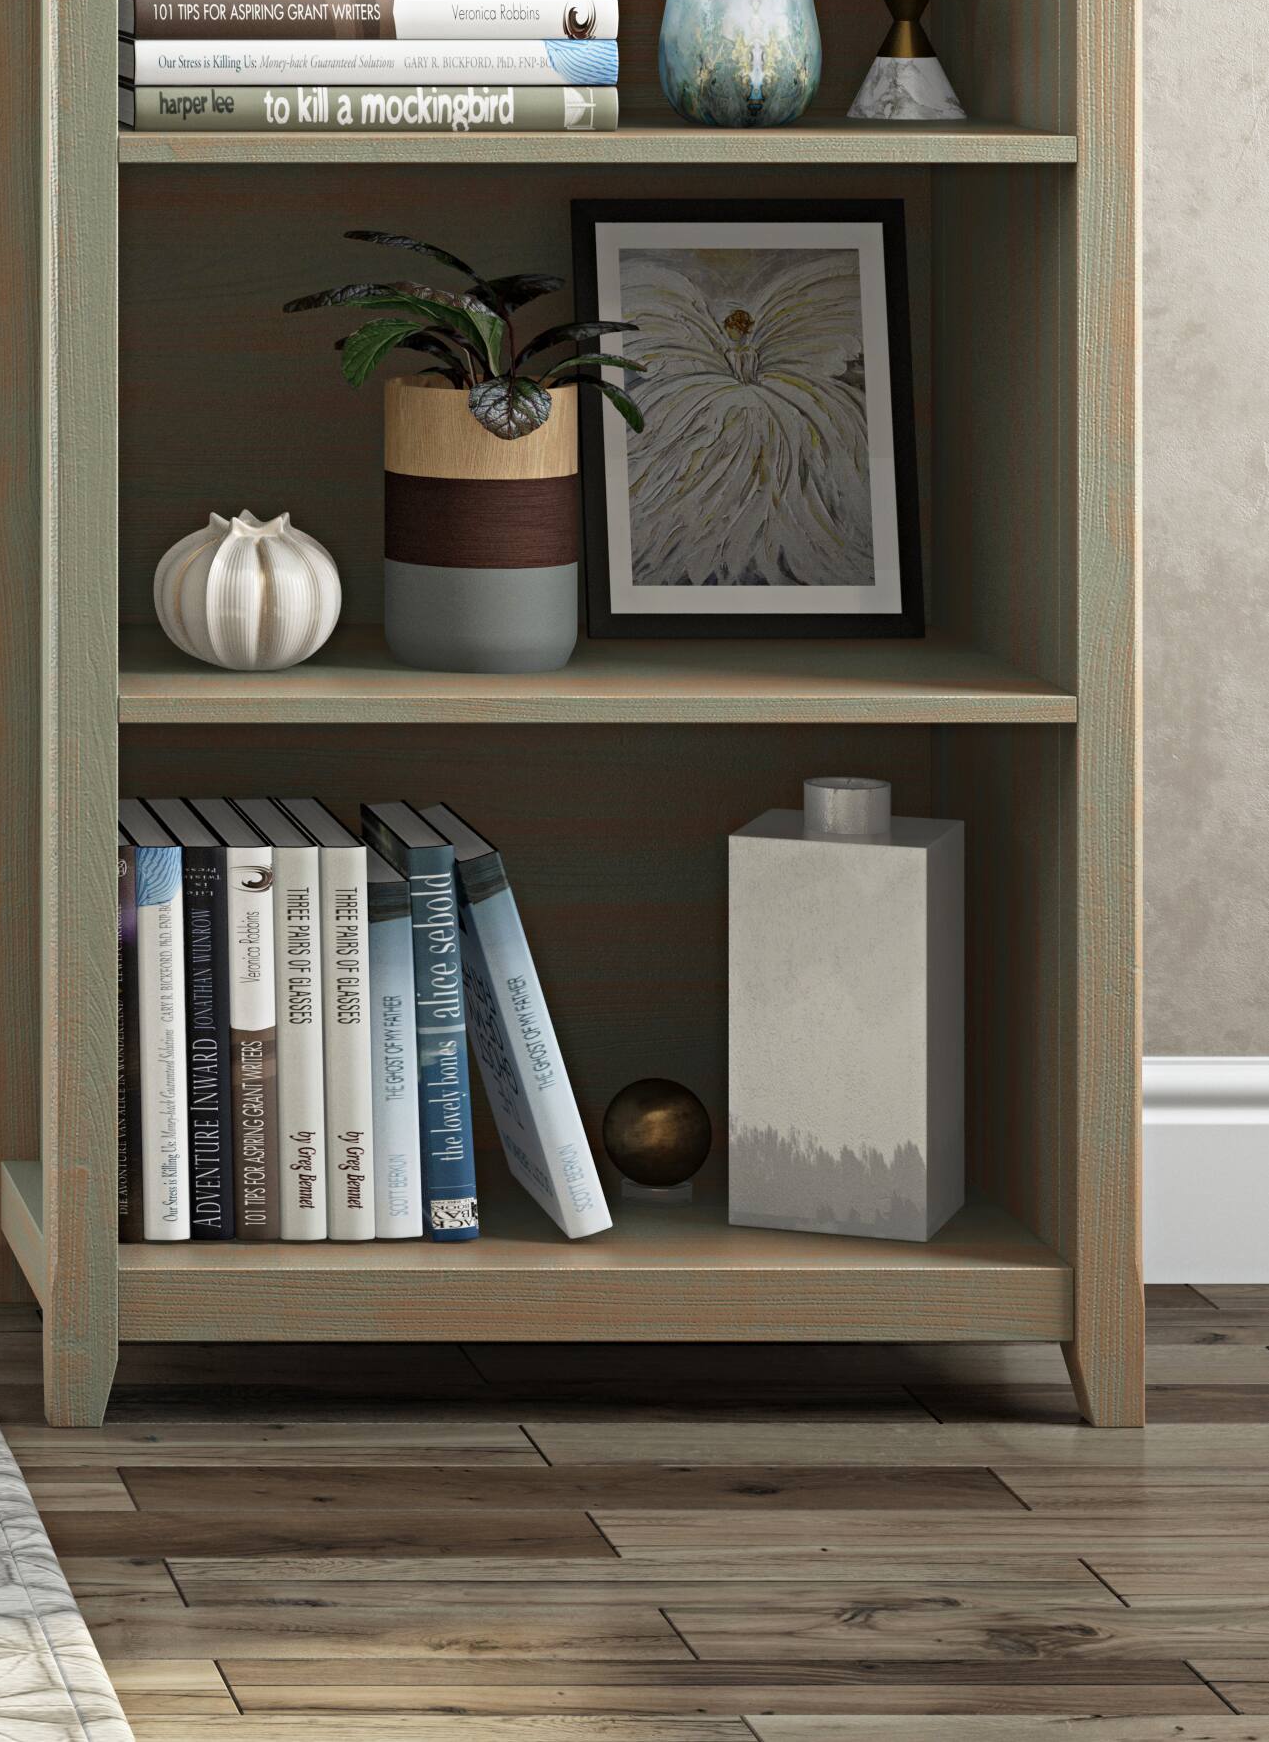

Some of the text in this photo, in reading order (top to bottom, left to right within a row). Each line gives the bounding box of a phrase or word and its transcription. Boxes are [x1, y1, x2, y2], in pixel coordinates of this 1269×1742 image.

[153, 3, 381, 20] 101 TIPS FOR ASPIRING GRANT WRITERS
[452, 4, 540, 21] Veronica Robbins
[158, 55, 176, 69] Our
[178, 55, 202, 69] Stress
[204, 56, 210, 69] is
[213, 55, 241, 73] Killing
[244, 55, 257, 69] Us:
[310, 54, 357, 69] Guaranteed
[358, 54, 395, 69] Solutions
[404, 57, 428, 69] GARY
[159, 90, 234, 120] harper lee
[264, 87, 514, 132] to kill a mockingbird
[236, 911, 261, 983] Veronica Robbins
[287, 887, 312, 1024] THREE PAIRS OF GLASSES
[335, 887, 361, 1024] THREE PAIRS OF GLASSES
[409, 872, 461, 1018] alice sebold
[191, 908, 216, 1031] JONATHAN WUNROW
[160, 1003, 173, 1022] GARY
[507, 974, 556, 1091] THE GHOST OF MY FATHER
[383, 995, 405, 1102] THE GHOST OF MY FATHER
[426, 1040, 459, 1086] bones
[190, 1038, 221, 1228] ADVENTURE INWARD
[428, 1088, 467, 1133] lovely
[161, 1141, 177, 1152] Us:
[240, 1041, 267, 1226] 101 TIPS FOR ASPIRING GRANT WRITERS
[432, 1136, 464, 1161] the
[161, 1154, 180, 1178] Killing
[289, 1131, 317, 1209] by Greg Bennet
[337, 1131, 365, 1209] by Greg Bennet
[387, 1154, 409, 1217] SCOTT BERKUN
[162, 1187, 178, 1207] Stress
[162, 1208, 178, 1222] Our
